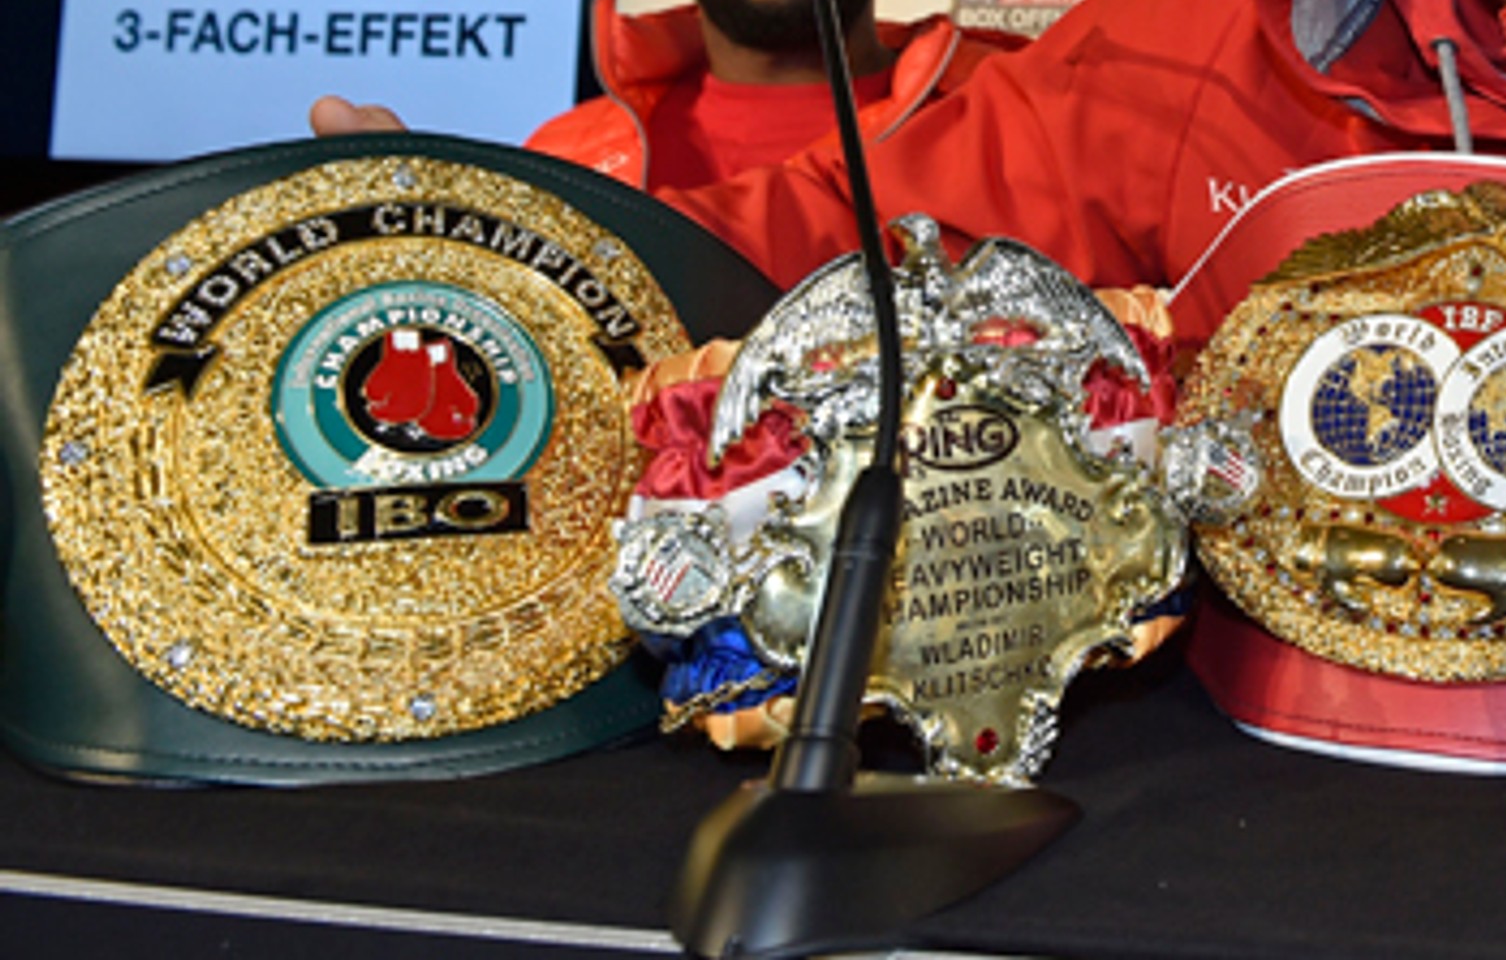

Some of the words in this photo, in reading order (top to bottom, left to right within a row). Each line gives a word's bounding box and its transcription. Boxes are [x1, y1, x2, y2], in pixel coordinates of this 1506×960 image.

[113, 9, 527, 58] 3-FACH-EFFEKT
[159, 217, 340, 346] WORLD
[372, 203, 643, 340] CHAMPION
[1339, 318, 1437, 352] World
[1443, 305, 1504, 331] IBF
[1300, 448, 1428, 498] Champion
[335, 489, 509, 538] IBO
[902, 478, 993, 521] AZINE
[1000, 478, 1094, 522] AWARD
[921, 512, 1027, 551] WORLD
